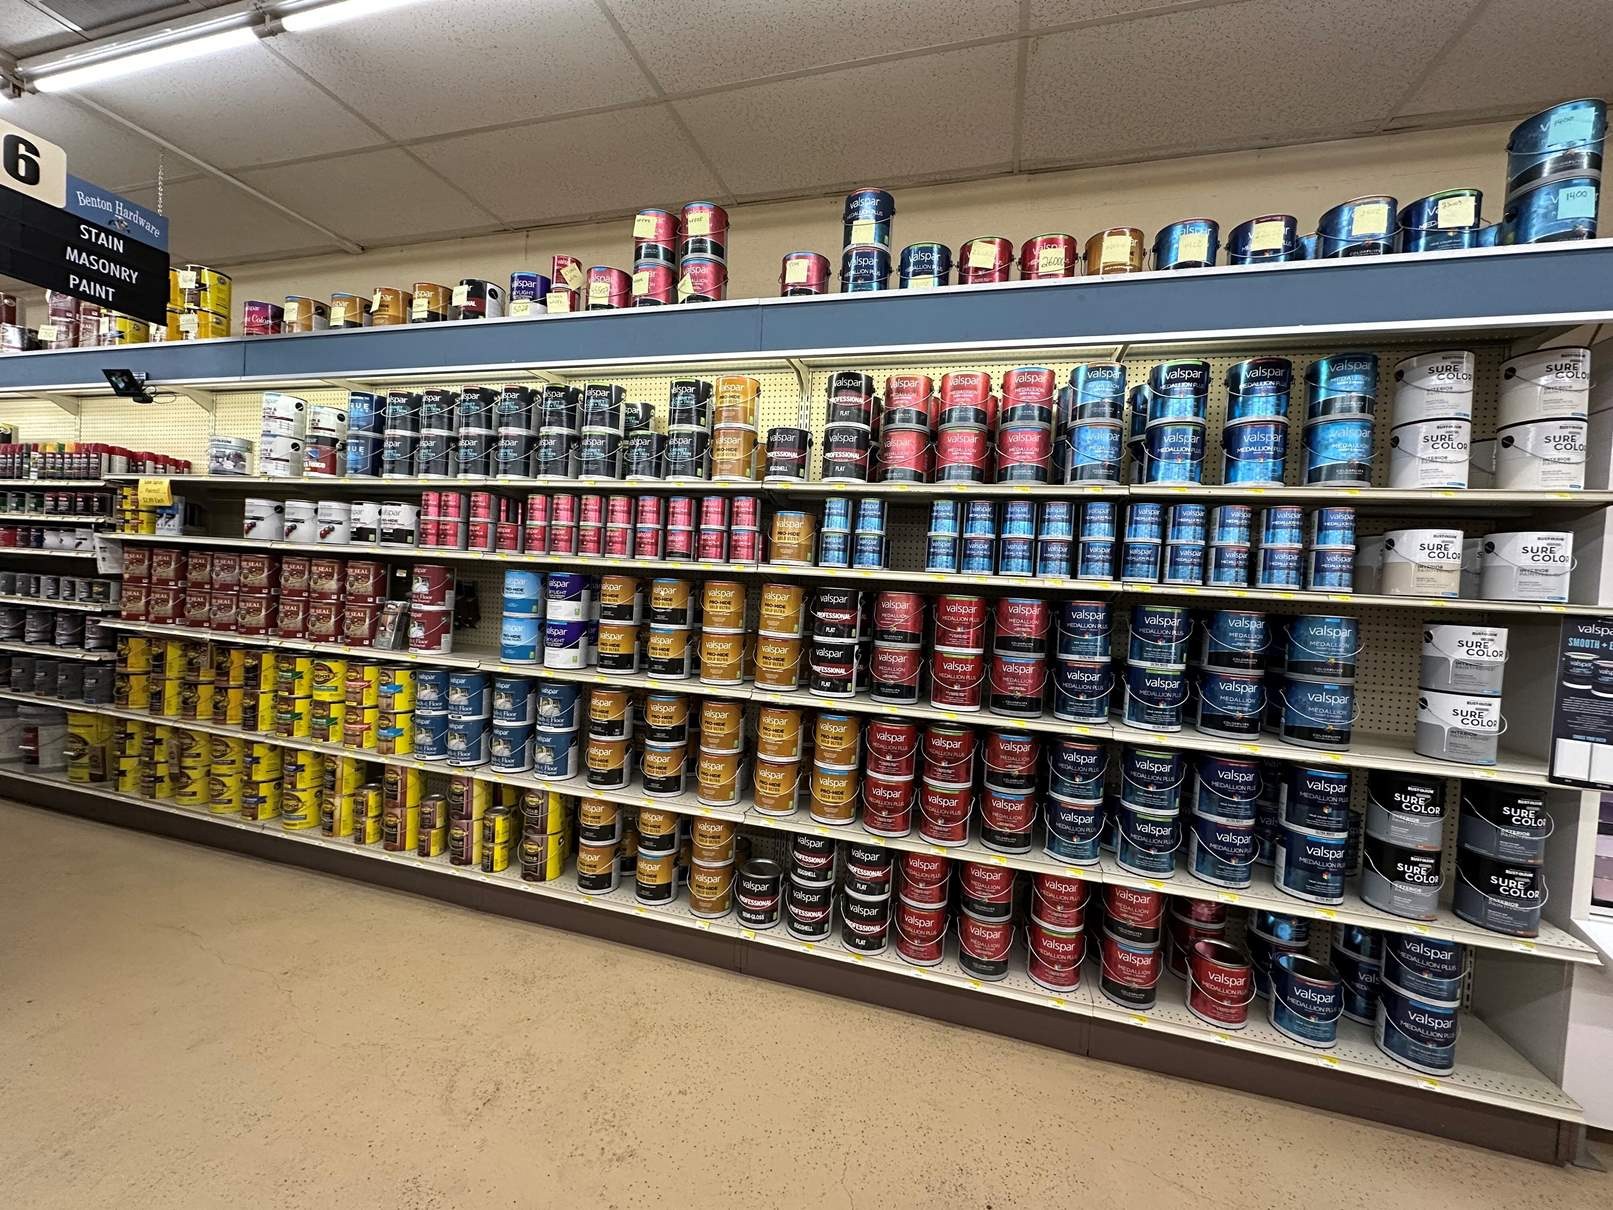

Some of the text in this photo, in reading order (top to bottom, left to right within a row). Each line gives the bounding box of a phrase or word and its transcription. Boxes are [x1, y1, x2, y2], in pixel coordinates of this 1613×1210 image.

[4, 134, 40, 186] 6
[77, 191, 160, 237] Benton Hardware
[80, 224, 123, 253] STAIN
[66, 247, 138, 284] MASONRY
[70, 274, 115, 301] PAINT
[1329, 360, 1372, 372] valspar
[1428, 365, 1460, 374] SURE
[1546, 364, 1579, 372] SURE
[1165, 368, 1203, 381] valspar
[1244, 367, 1284, 379] valspar
[1244, 433, 1282, 445] valspar
[1423, 435, 1453, 443] SURE
[1544, 435, 1577, 443] SURE
[776, 519, 803, 528] valspar
[1521, 546, 1556, 554] SURE
[708, 589, 734, 599] valspar
[820, 595, 848, 605] valspar
[881, 600, 910, 610] valspar
[946, 604, 977, 614] valspar
[1008, 605, 1041, 616] valspar
[1072, 610, 1106, 621] valspar
[1145, 615, 1181, 627] valspar
[1228, 618, 1264, 630] valspar
[1309, 626, 1352, 638] valspar
[1578, 625, 1613, 636] valspa
[706, 642, 732, 651] valspar
[762, 645, 788, 654] valspar
[1457, 640, 1489, 649] SURE
[1568, 638, 1600, 649] SMOOTH
[816, 648, 844, 659] valspar
[878, 653, 907, 663] valspar
[1466, 649, 1504, 657] COLOR
[943, 661, 975, 672] valspar
[1002, 664, 1035, 675] valspar
[1067, 671, 1101, 682] valspar
[1145, 678, 1180, 690] valspar
[1220, 681, 1258, 694] valspar
[1220, 695, 1256, 703] MEDALLION
[1307, 691, 1349, 706] valspar
[1308, 707, 1347, 715] MEDALLION
[1452, 709, 1484, 718] SURE
[820, 723, 847, 733] valspar
[1461, 718, 1497, 727] COLOR
[877, 732, 905, 742] valspar
[932, 738, 961, 749] valspar
[1000, 742, 1031, 752] valspar
[1062, 752, 1097, 764] valspar
[1135, 759, 1172, 774] valspar
[1130, 770, 1161, 781] MEDALLION
[1218, 769, 1254, 782] valspar
[819, 777, 848, 787] valspar
[1307, 780, 1347, 793] valspar
[872, 787, 901, 798] valspar
[928, 795, 958, 806] valspar
[1394, 793, 1426, 805] SURE
[992, 800, 1024, 811] valspar
[1402, 802, 1440, 815] COLOR
[1060, 812, 1094, 824] valspar
[1502, 806, 1535, 818] SURE
[698, 822, 723, 832] valspar
[1512, 816, 1546, 827] COLOR
[1135, 823, 1171, 836] valspar
[797, 835, 824, 848] valspar
[1216, 832, 1251, 846] valspar
[852, 849, 880, 861] valspar
[1306, 845, 1344, 859] valspar
[909, 858, 938, 870] valspar
[1299, 857, 1336, 868] MEDALLION
[971, 868, 1002, 880] valspar
[1397, 863, 1427, 876] SURE
[1405, 873, 1439, 884] COLOR
[1490, 875, 1525, 889] SURE
[743, 880, 769, 891] valspar
[1044, 880, 1077, 892] valspar
[793, 889, 820, 902] valspar
[1115, 888, 1151, 904] valspar
[1500, 886, 1539, 899] COLOR
[850, 904, 878, 915] valspar
[1116, 903, 1148, 914] MEDALLION
[904, 915, 934, 927] valspar
[970, 926, 1001, 938] valspar
[1042, 938, 1074, 951] valspar
[1404, 940, 1452, 960] valspar
[1118, 951, 1152, 965] valspar
[1399, 953, 1438, 969] MEDALLION
[1118, 964, 1149, 974] MEDALLION
[1207, 970, 1245, 986] valspar
[1294, 985, 1335, 1003] valspar
[1408, 1009, 1452, 1028] valspar
